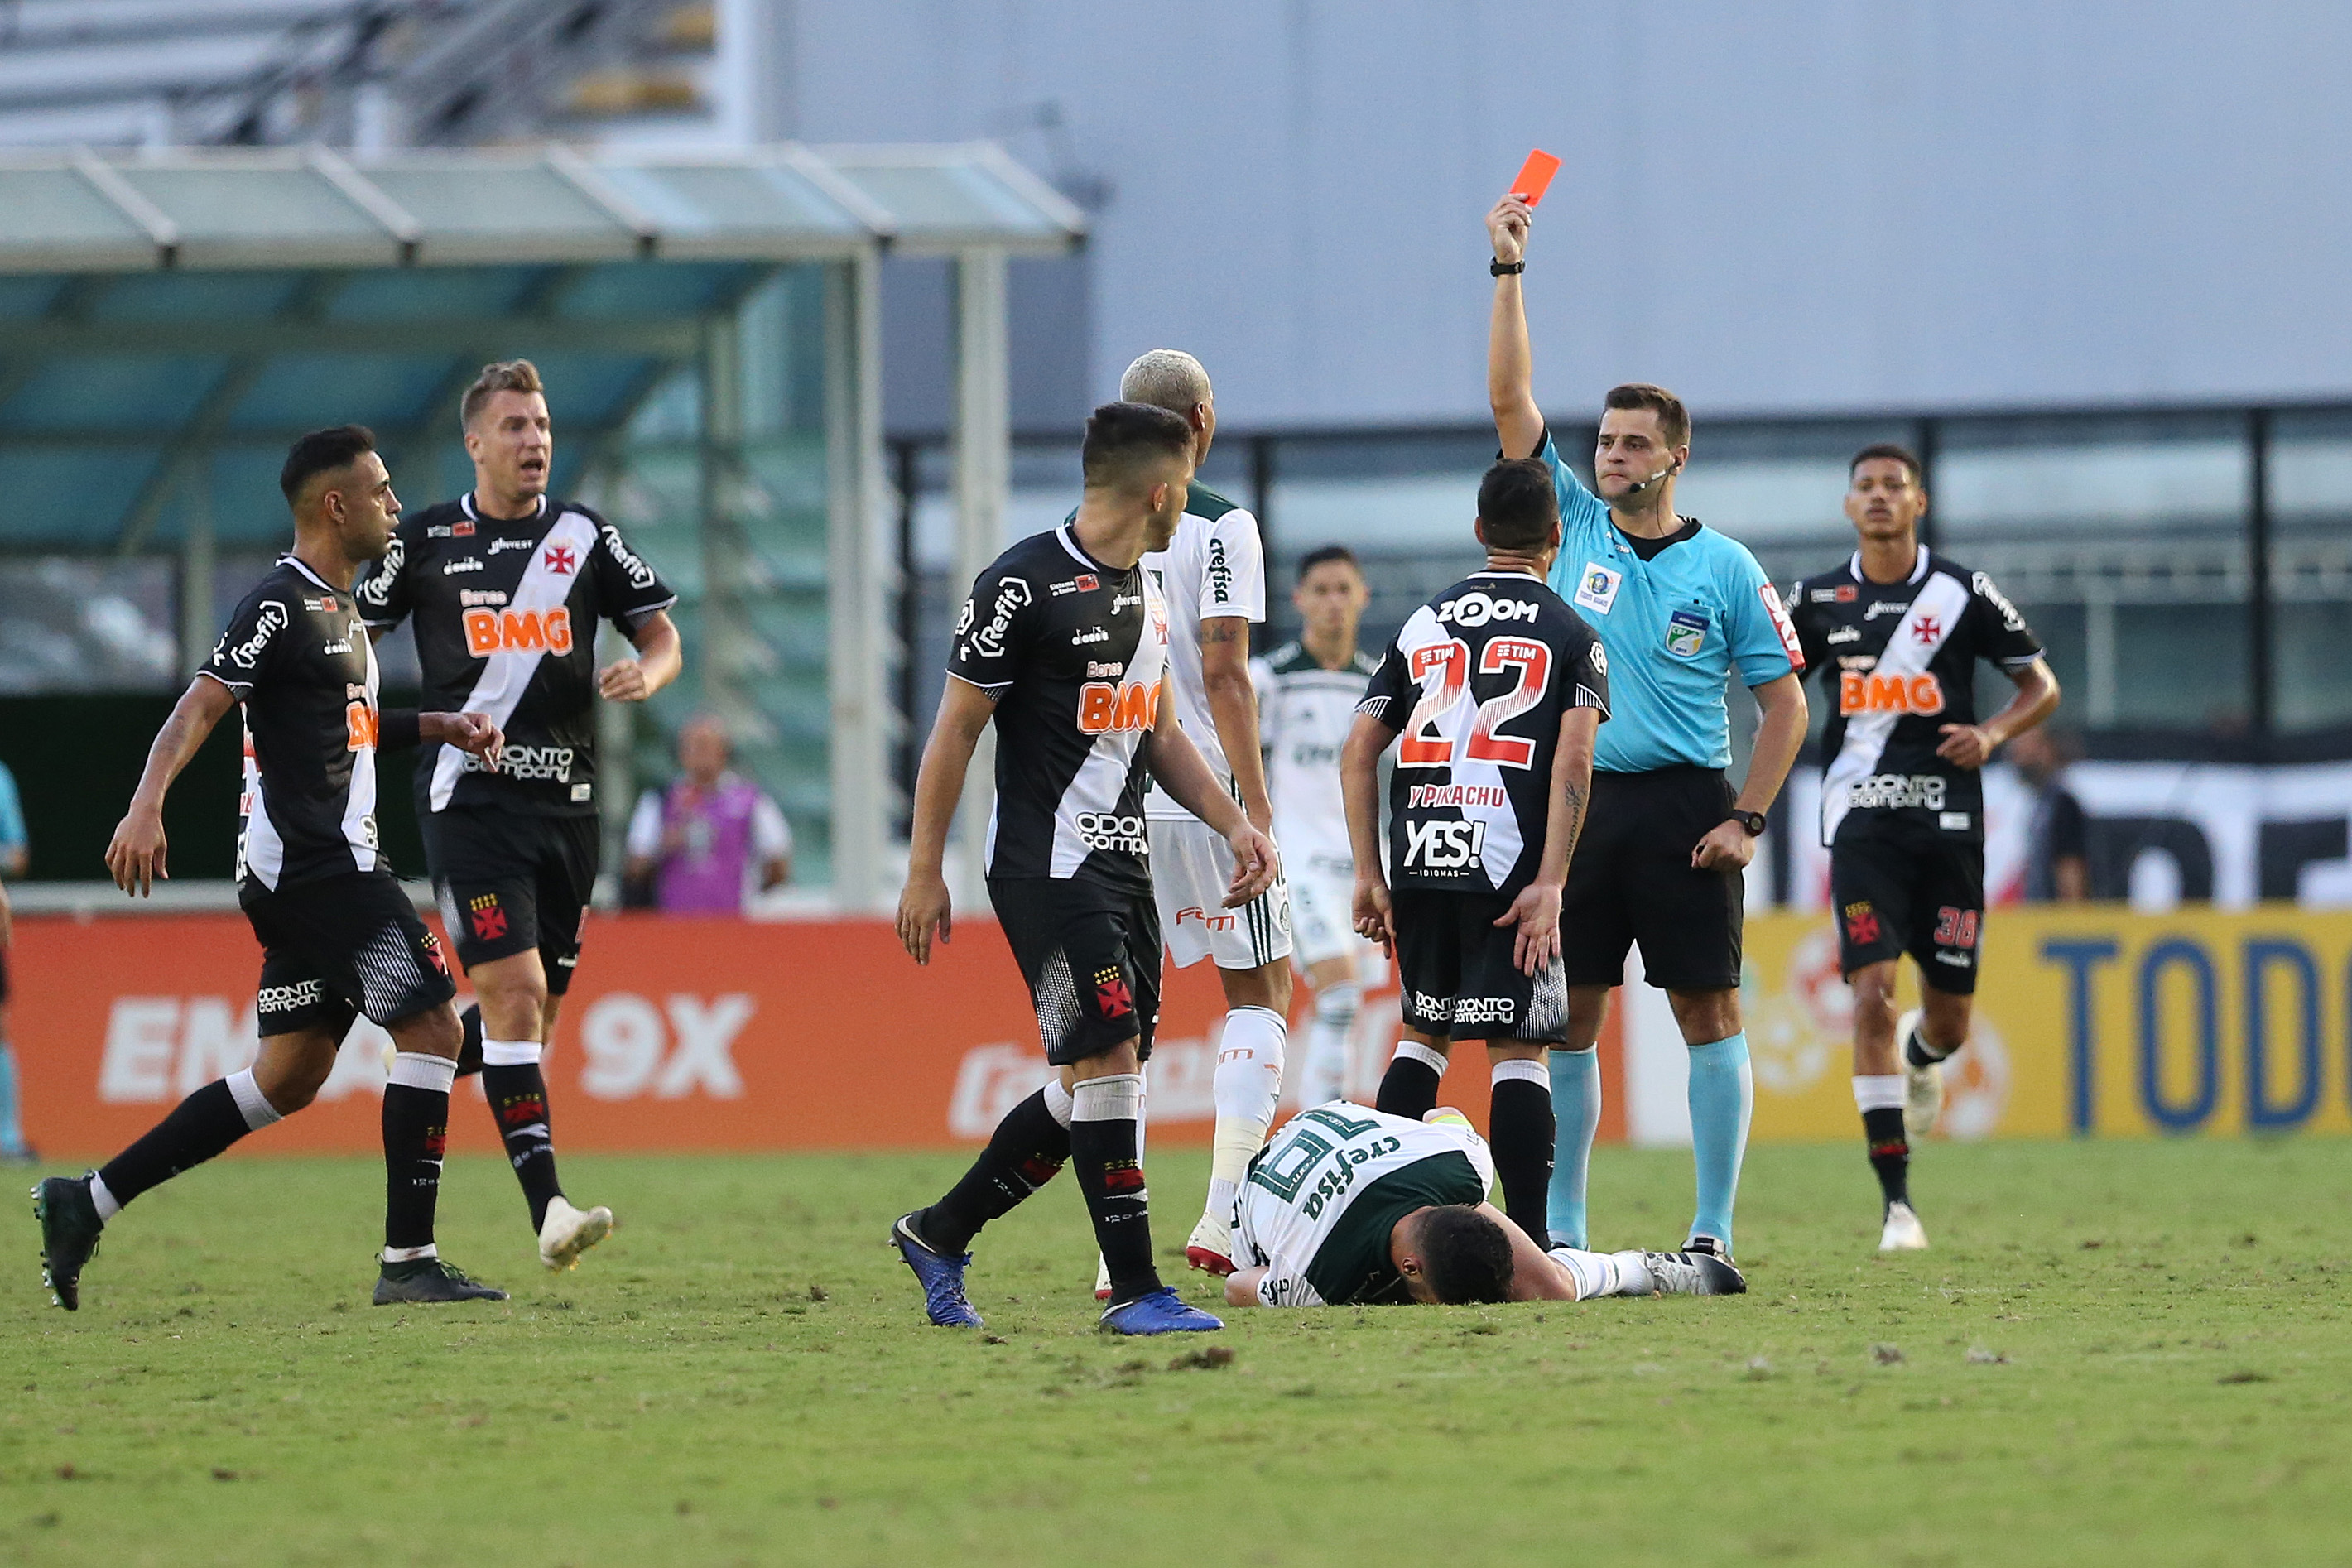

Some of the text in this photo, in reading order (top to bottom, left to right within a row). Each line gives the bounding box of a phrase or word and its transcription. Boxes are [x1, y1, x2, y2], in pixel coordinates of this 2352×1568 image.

[1209, 538, 1232, 604] crefisa
[463, 608, 572, 657] BMG
[1433, 646, 1455, 661] TIM
[1512, 647, 1537, 660] TIM
[1397, 636, 1553, 771] 22
[1840, 671, 1945, 717] BMG
[1403, 820, 1486, 869] YES!
[1418, 869, 1460, 878] IDIOMAS
[1934, 906, 1980, 949] 38
[581, 993, 754, 1100] 9X
[2039, 936, 2352, 1135] TOD
[1301, 1136, 1401, 1223] crefisa
